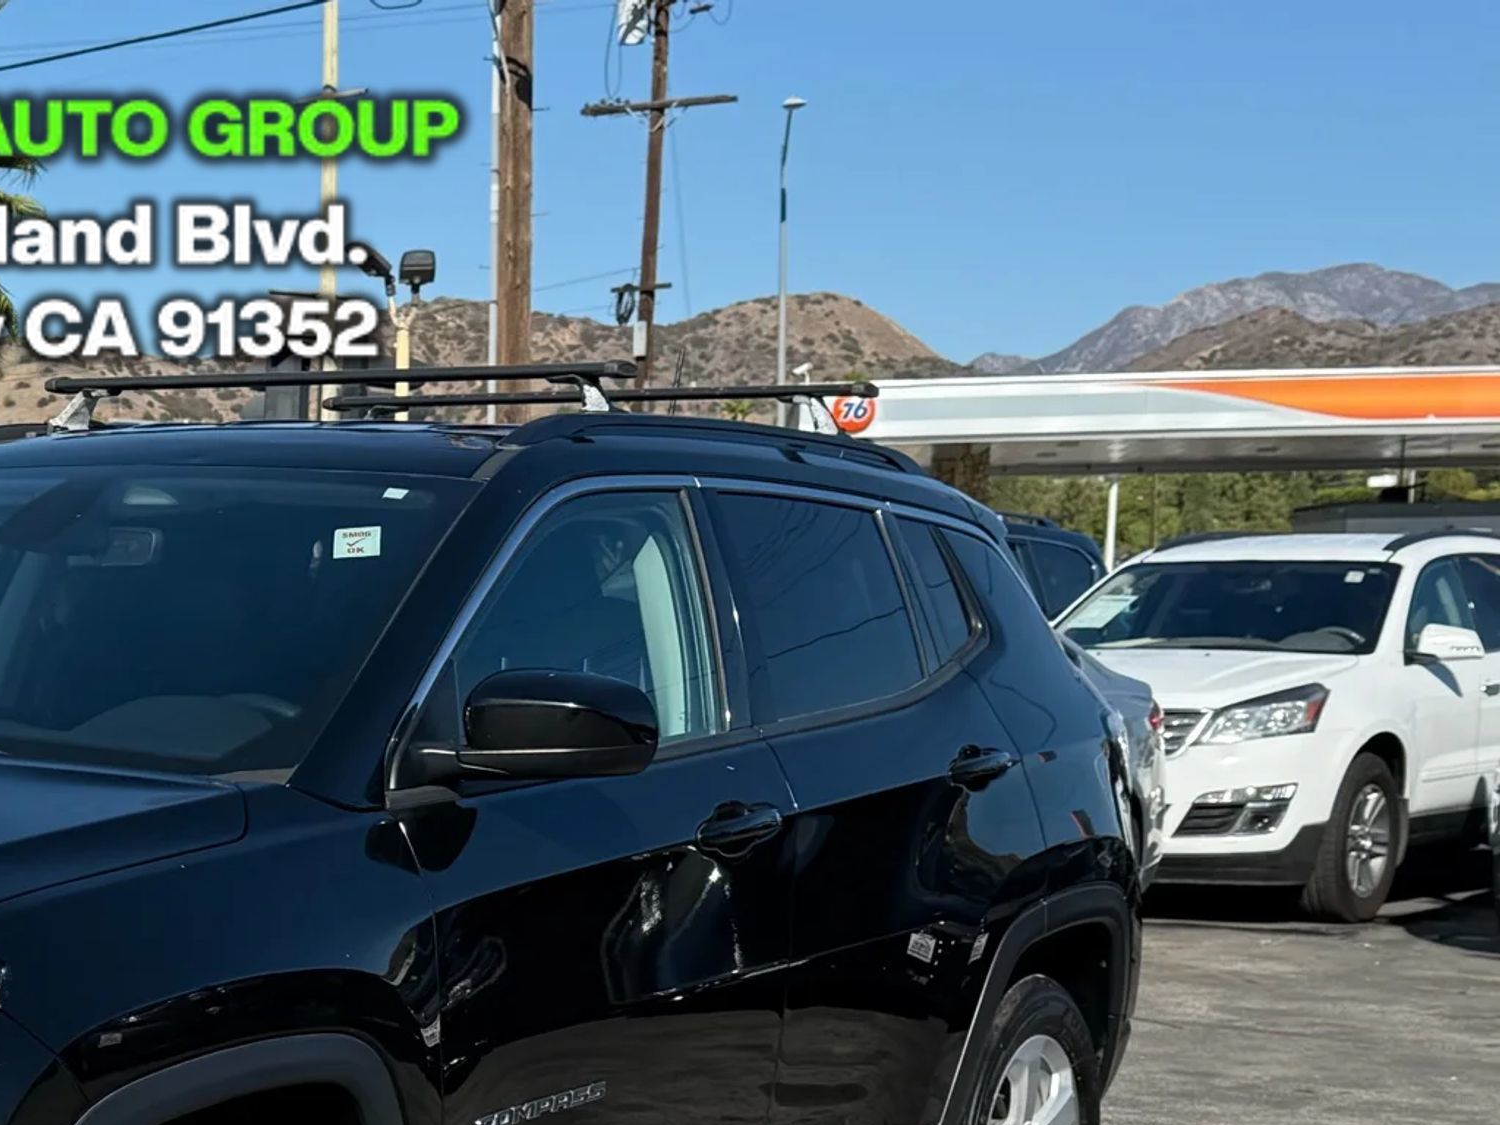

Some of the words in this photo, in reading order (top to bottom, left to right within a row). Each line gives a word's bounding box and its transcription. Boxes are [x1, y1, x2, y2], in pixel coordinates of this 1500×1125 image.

[842, 400, 868, 419] 76
[342, 530, 372, 539] SMOG
[347, 546, 365, 554] OK
